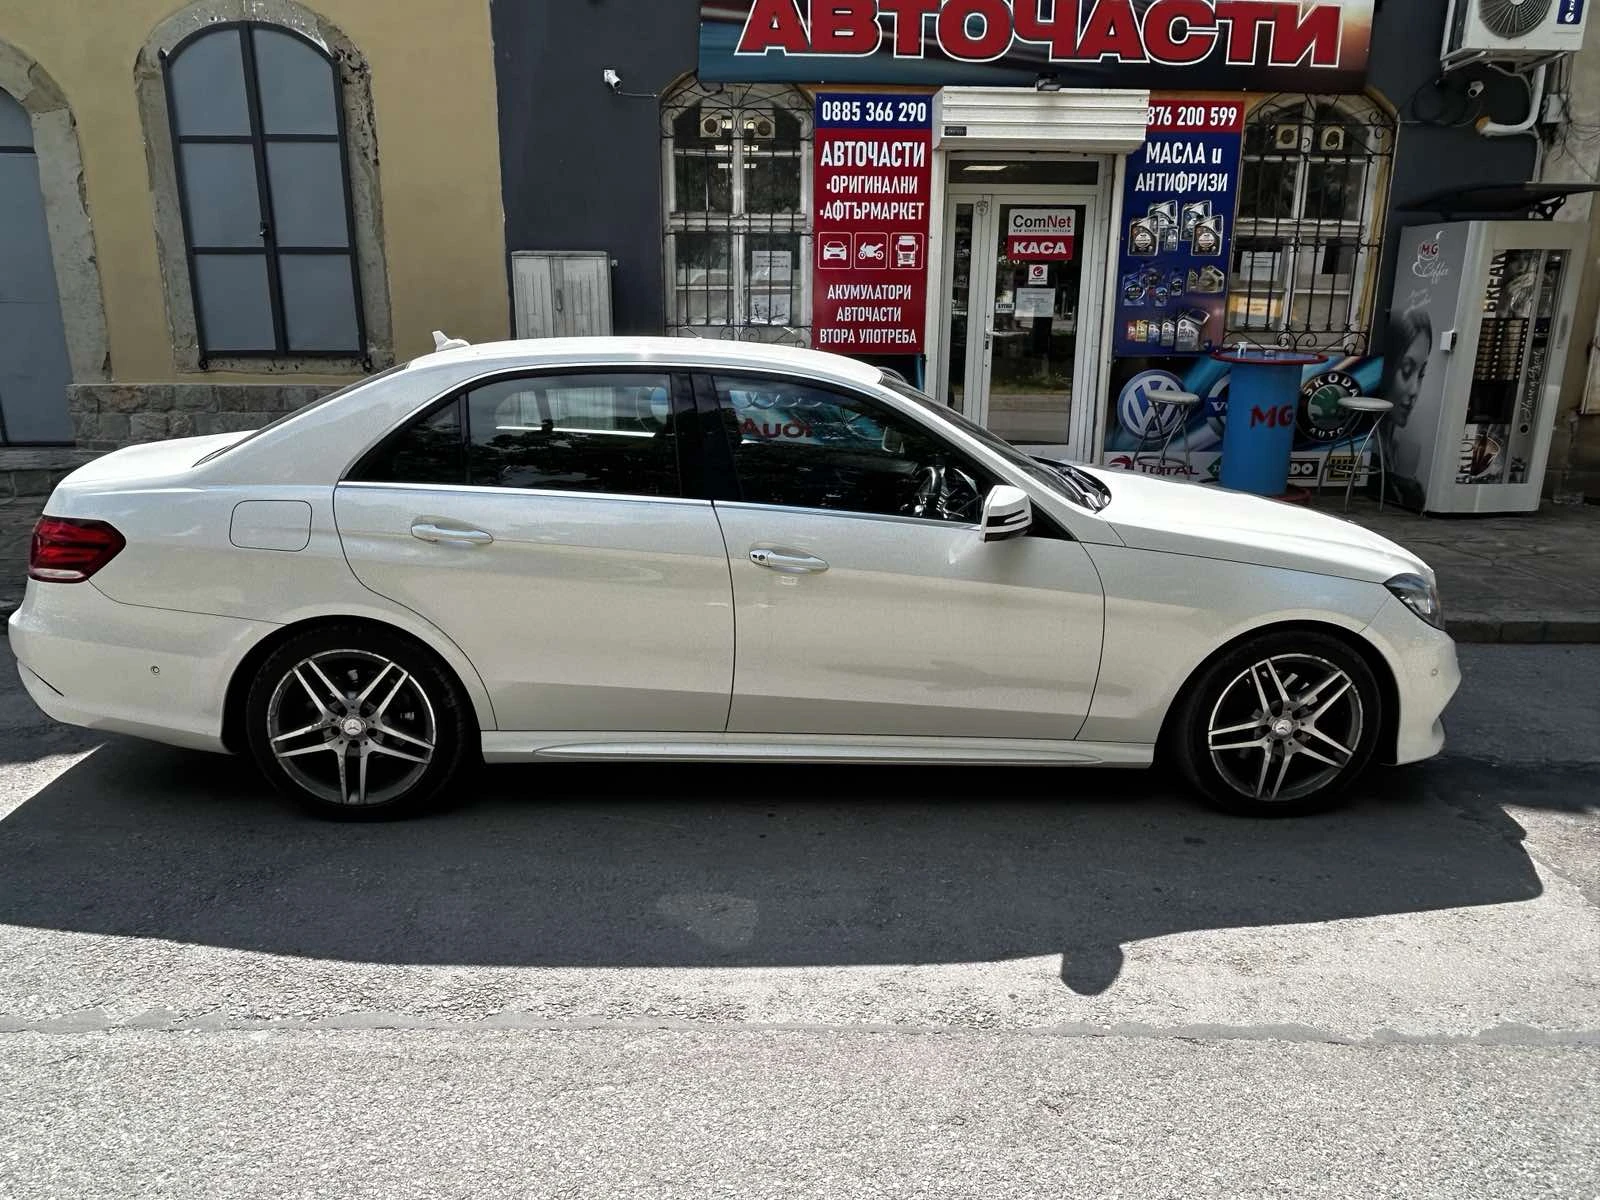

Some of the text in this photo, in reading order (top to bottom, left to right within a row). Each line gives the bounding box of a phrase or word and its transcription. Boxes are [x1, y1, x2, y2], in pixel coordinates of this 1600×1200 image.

[733, 0, 1342, 67] АВТОЧАСТИ
[822, 101, 927, 122] 0885 366 290
[1147, 106, 1238, 126] 876 200 599
[820, 141, 926, 168] АВТОЧАСТИ
[1146, 142, 1206, 164] МАСЛА
[1134, 171, 1229, 193] АНТИФРИЗИ
[1013, 214, 1072, 229] ComNet
[1013, 241, 1067, 255] КАСА
[827, 284, 911, 300] АКУМУЛАТОРИ
[836, 307, 902, 322] АВТОЧАСТИ
[820, 329, 917, 344] ВТОРА УПОТРЕБА
[1251, 404, 1294, 429] MG
